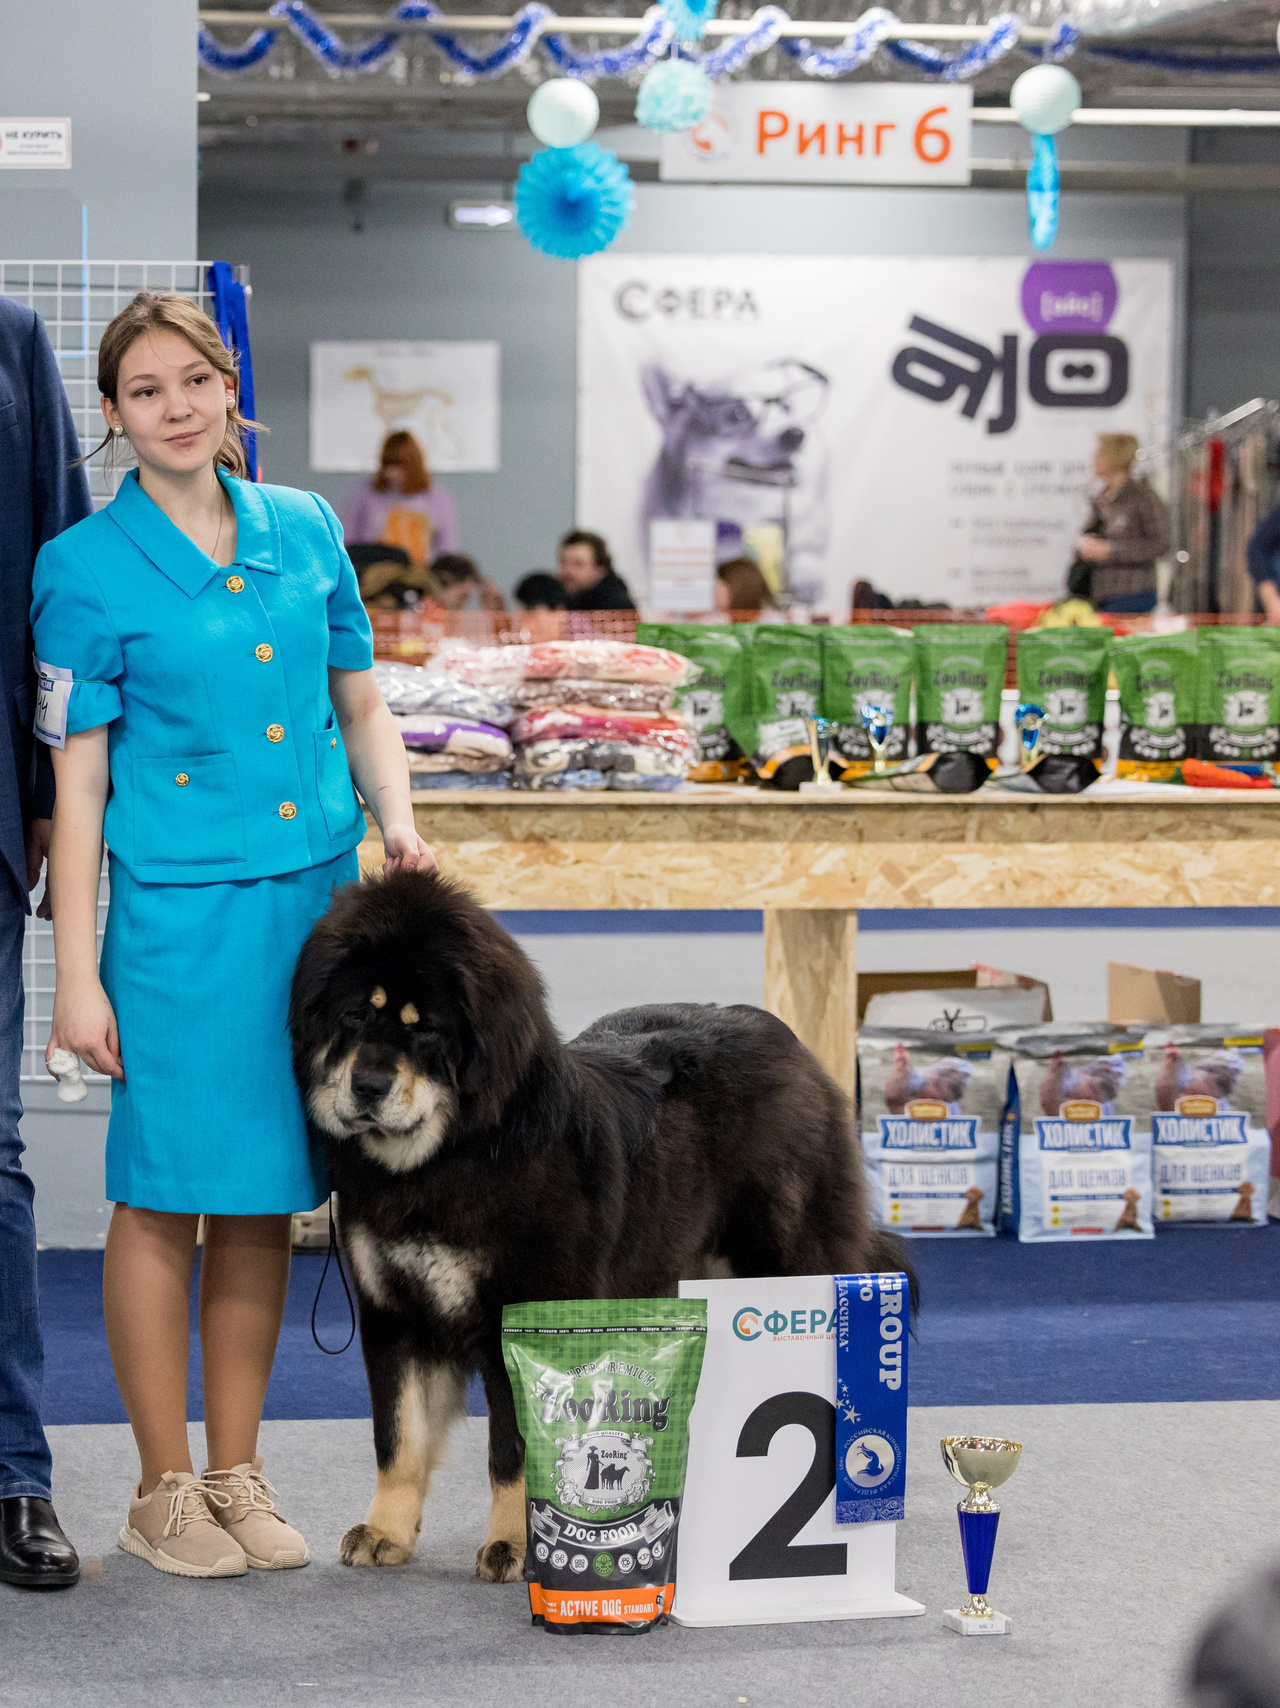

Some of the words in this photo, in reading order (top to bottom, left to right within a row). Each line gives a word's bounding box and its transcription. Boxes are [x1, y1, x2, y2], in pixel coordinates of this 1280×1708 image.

[5, 131, 18, 139] НЕ
[22, 131, 62, 139] КУРИТЬ
[757, 110, 896, 156] Ринг
[913, 106, 951, 164] 6
[614, 280, 760, 324] СФЕРА
[886, 1121, 972, 1147] ХОЛИСТИК
[1042, 1121, 1126, 1148] ХОЛИСТИК
[1156, 1117, 1242, 1143] ХОЛИСТИК
[889, 1168, 915, 1186] ДЛЯ
[919, 1167, 968, 1186] ЩЕНКОВ
[1049, 1170, 1073, 1188] ДЛЯ
[1077, 1169, 1126, 1188] ЩЕНКОВ
[1160, 1164, 1187, 1183] ДЛЯ
[1191, 1163, 1242, 1182] ЩЕНКОВ
[772, 1334, 825, 1342] ВЫСТАВОЧНЫЙ
[879, 1273, 903, 1391] GROUP
[603, 1361, 656, 1387] PREMIUM
[542, 1389, 670, 1432] ZooRing
[843, 1427, 887, 1449] РОССИЙСКАЯ
[601, 1450, 628, 1460] ZooRing
[729, 1391, 848, 1581] 2
[563, 1523, 596, 1542] DOG
[600, 1522, 638, 1542] FOOD
[560, 1600, 598, 1617] ACTIVE
[602, 1599, 622, 1616] DOG
[623, 1603, 654, 1614] STANDART
